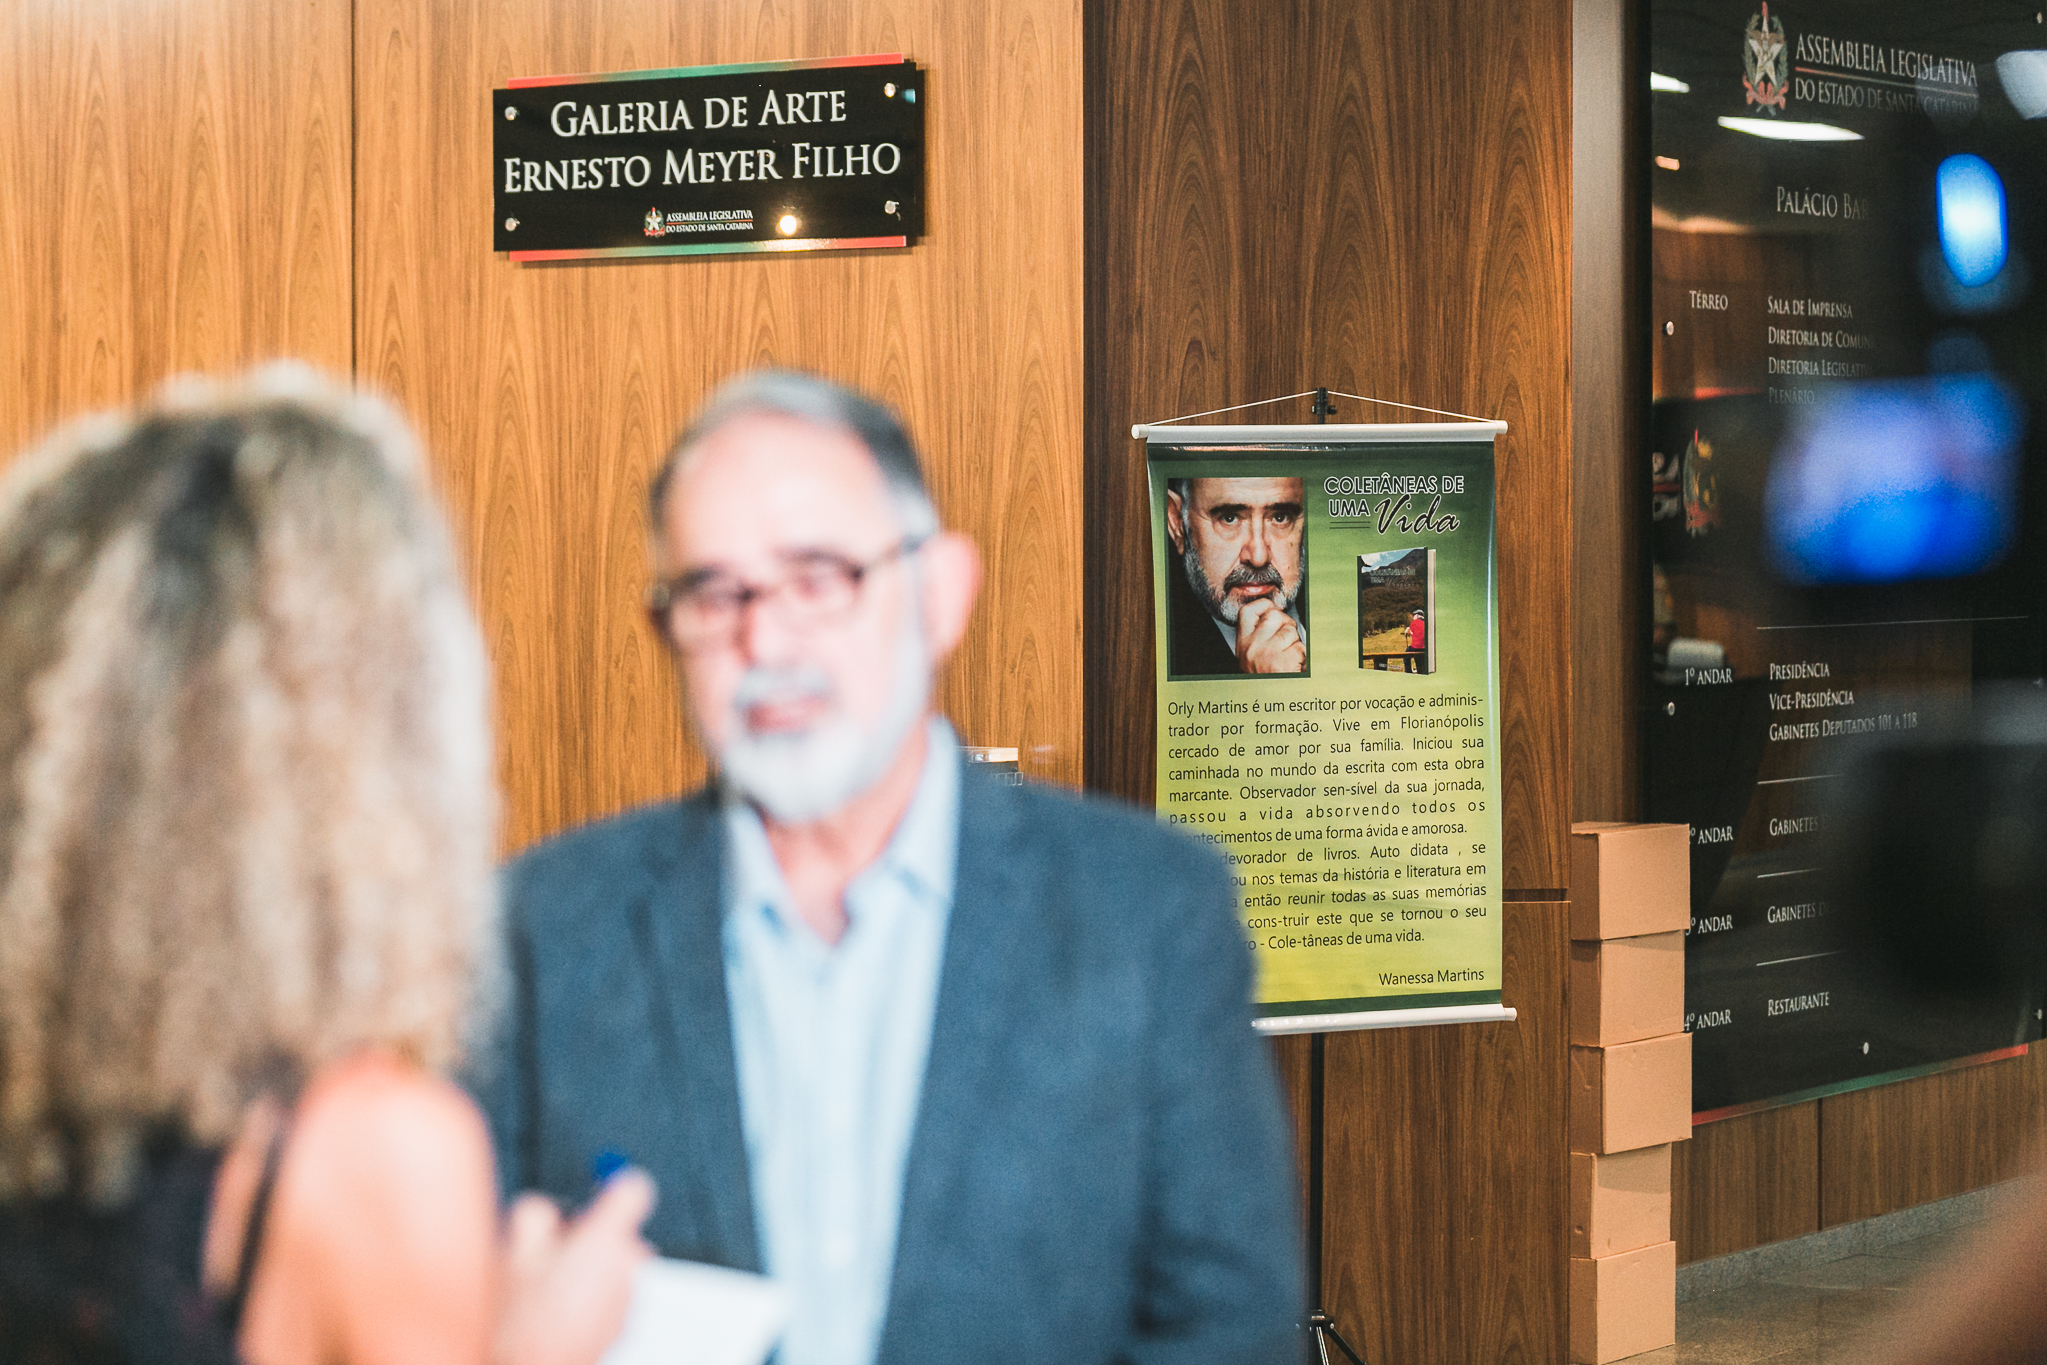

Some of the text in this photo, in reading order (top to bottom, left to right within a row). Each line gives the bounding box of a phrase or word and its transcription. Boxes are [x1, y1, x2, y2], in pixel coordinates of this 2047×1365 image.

[1796, 33, 1978, 87] ASSEMBLEIA LEGISLATIVA
[1795, 77, 1815, 101] DO
[1818, 80, 1864, 108] ESTADO
[1868, 87, 1884, 110] DE
[551, 90, 846, 138] GALERIA DE ARTE
[504, 142, 900, 193] ERNESTO MEYER FILHO
[1776, 186, 1838, 218] PALÁCIO
[666, 209, 754, 222] ASSEMBLEIA LEGISLATIVA
[666, 222, 754, 233] DO ESTADO DE SANTA CATARINA
[1690, 290, 1728, 310] TÉRREO
[1767, 295, 1853, 319] SALA DE IMPRENSA
[1768, 326, 1819, 347] DIRETORIA
[1822, 331, 1833, 348] DE
[1768, 357, 1819, 376] DIRETORIA
[1768, 386, 1815, 405] PLENÁRIO
[1324, 472, 1464, 495] COLETÂNEAS DE
[1329, 494, 1460, 535] UMA Vida
[1684, 668, 1732, 686] 1º ANDAR
[1770, 660, 1830, 680] PRESIDÊNCIA
[1168, 694, 1483, 718] Orly Martins é um escritor por vocação e adminis-
[1770, 689, 1854, 710] VICE-PRESIDÊNCIA
[1168, 714, 1484, 738] trador por formação. Vive em Florianópolis
[1770, 722, 1819, 741] GABINETES
[1822, 716, 1875, 736] DEPUTADOS
[1168, 737, 1484, 758] cercado de amor por sua família. Iniciou sua
[1169, 757, 1484, 780] caminhada no mundo da escrita com esta obra
[1169, 778, 1485, 802] marcante. Observador sen-sível da sua jornada,
[1170, 801, 1485, 827] passou a vida absorvendo todos os
[1275, 826, 1292, 840] de
[1294, 828, 1322, 839] uma
[1326, 824, 1363, 838] forma
[1366, 822, 1399, 837] ávida
[1402, 825, 1408, 835] e
[1412, 822, 1467, 835] amorosa.
[1698, 826, 1733, 843] ANDAR
[1770, 816, 1818, 836] GABINETES
[1297, 849, 1313, 862] de
[1323, 847, 1359, 861] livros.
[1371, 846, 1400, 859] Auto
[1411, 843, 1448, 857] didata
[1472, 843, 1486, 854] se
[1252, 875, 1274, 885] nos
[1280, 872, 1317, 884] temas
[1323, 870, 1338, 882] da
[1343, 866, 1389, 881] história
[1394, 869, 1401, 879] e
[1407, 864, 1461, 878] literatura
[1466, 865, 1486, 875] em
[1244, 893, 1281, 907] então
[1288, 892, 1325, 905] reunir
[1331, 889, 1366, 903] todas
[1372, 891, 1386, 901] as
[1393, 889, 1419, 900] suas
[1426, 884, 1486, 898] memórias
[1248, 914, 1309, 929] cons-truir
[1317, 912, 1342, 924] este
[1349, 912, 1373, 927] que
[1381, 911, 1394, 921] se
[1401, 908, 1443, 920] tornou
[1450, 908, 1458, 918] o
[1465, 906, 1486, 917] seu
[1768, 903, 1816, 923] GABINETES
[1698, 915, 1733, 934] ANDAR
[1268, 932, 1343, 949] Cole-tâneas
[1347, 931, 1362, 945] de
[1365, 933, 1392, 943] uma
[1395, 929, 1424, 942] vida.
[1379, 967, 1484, 985] Wanessa Martins
[1768, 992, 1830, 1016] RESTAURANTE
[1684, 1009, 1732, 1031] 4º ANDAR
